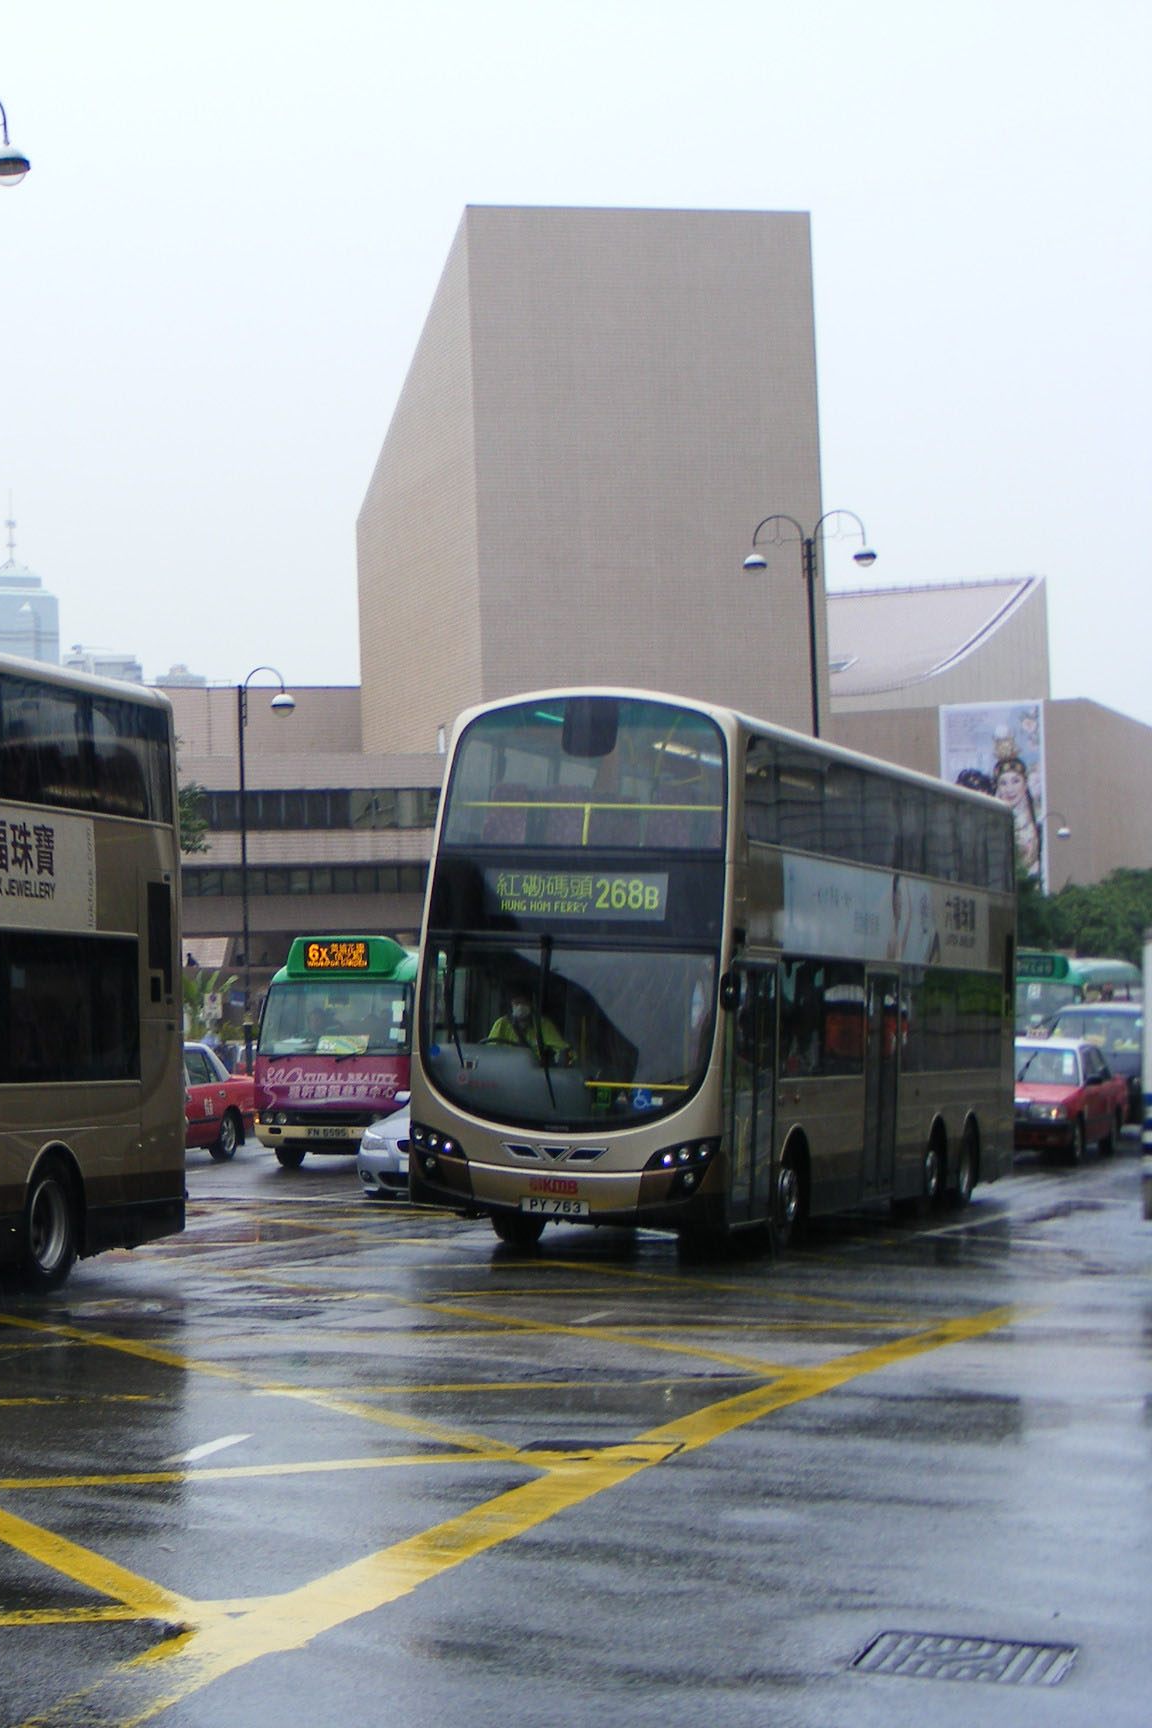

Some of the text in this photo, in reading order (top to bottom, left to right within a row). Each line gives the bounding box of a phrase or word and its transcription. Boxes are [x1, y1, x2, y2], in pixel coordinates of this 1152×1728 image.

[5, 878, 56, 900] JEWELLERY
[496, 873, 594, 899] 紅磡碼頭
[595, 879, 659, 910] 268B
[501, 900, 589, 913] HUNG HOM FERRY
[529, 1199, 546, 1211] PY
